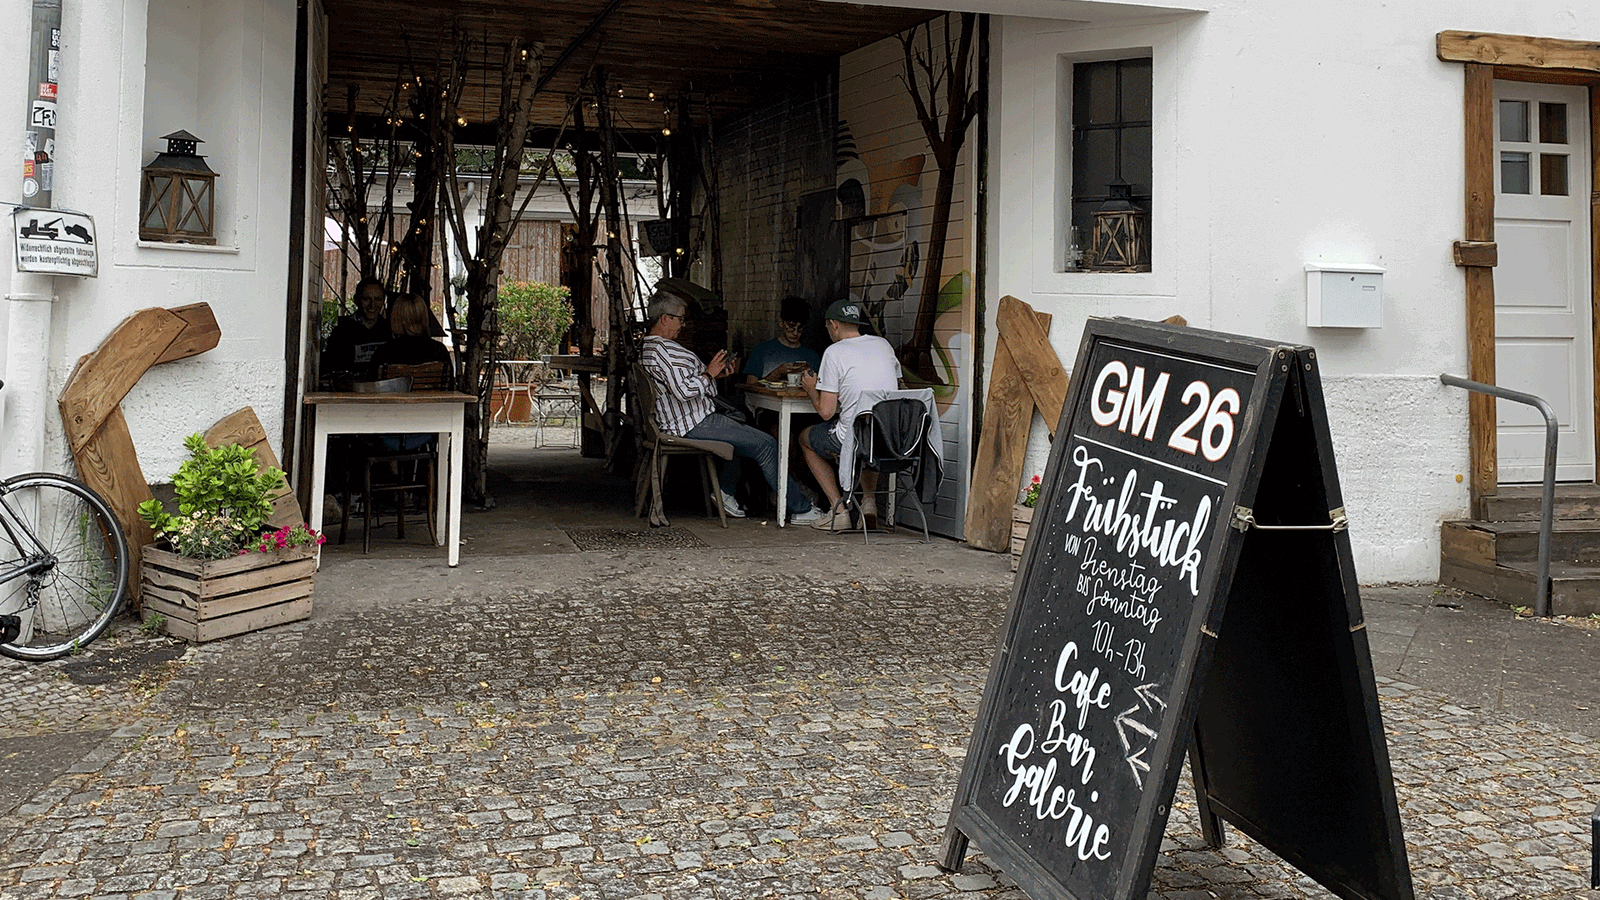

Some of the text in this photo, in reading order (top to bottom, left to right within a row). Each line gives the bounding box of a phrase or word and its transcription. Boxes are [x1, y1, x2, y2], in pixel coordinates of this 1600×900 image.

[1090, 360, 1241, 463] GM 26
[1065, 445, 1212, 596] Frühstück
[1064, 533, 1163, 604] VON Dienstag
[1076, 573, 1163, 634] BIS Sonntag
[1054, 641, 1112, 730] Cafe
[1040, 698, 1096, 785] Bar
[998, 723, 1112, 861] Galerie
